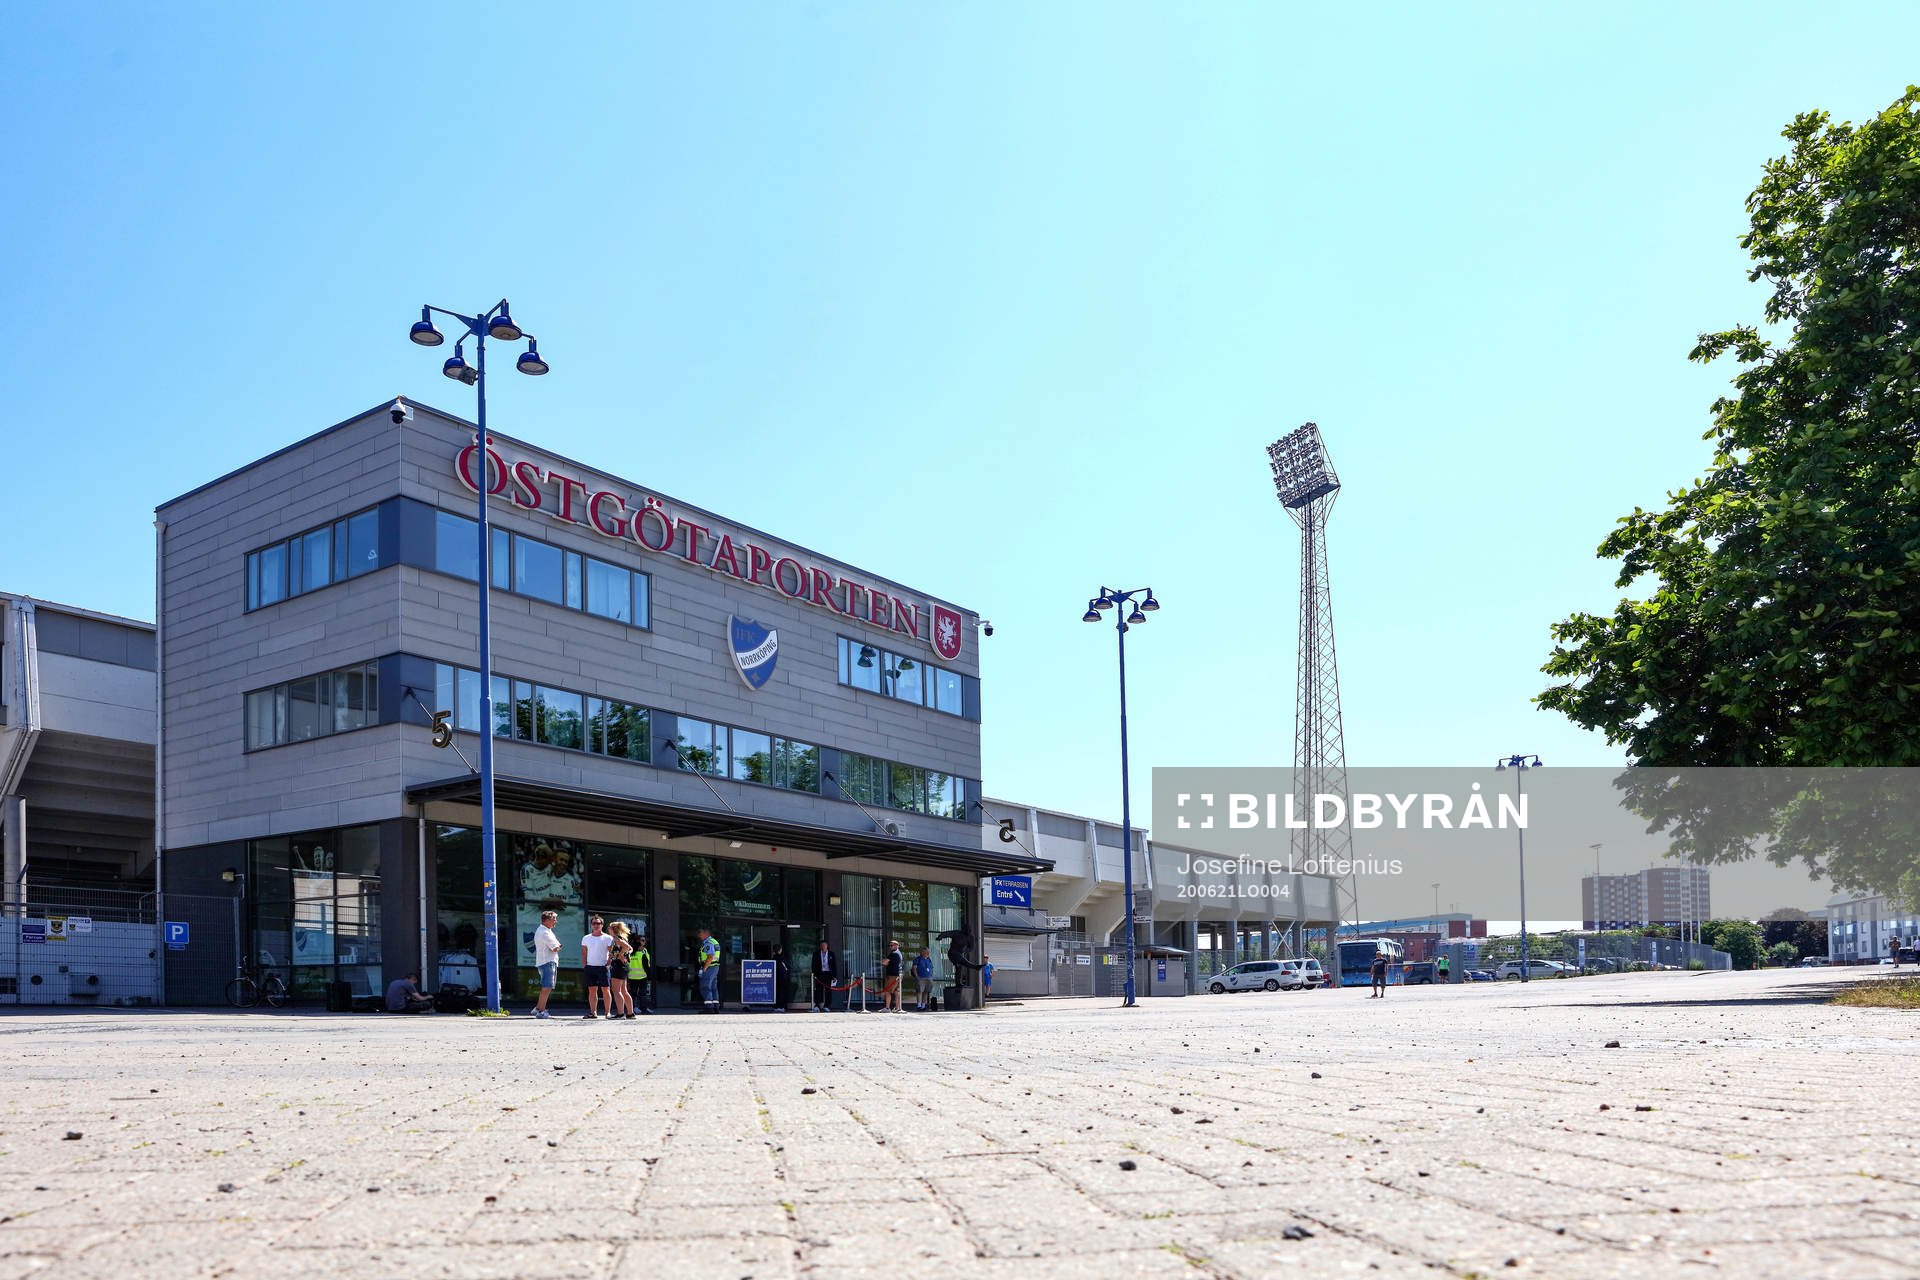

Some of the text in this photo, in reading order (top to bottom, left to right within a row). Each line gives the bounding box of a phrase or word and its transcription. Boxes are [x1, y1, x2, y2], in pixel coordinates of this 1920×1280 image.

[455, 432, 920, 638] ÖSTGÖTAPORTEN
[740, 639, 777, 666] NORRKÖPING
[432, 710, 452, 748] 5
[996, 890, 1013, 899] Entré
[891, 899, 921, 914] 2015
[172, 925, 184, 940] P
